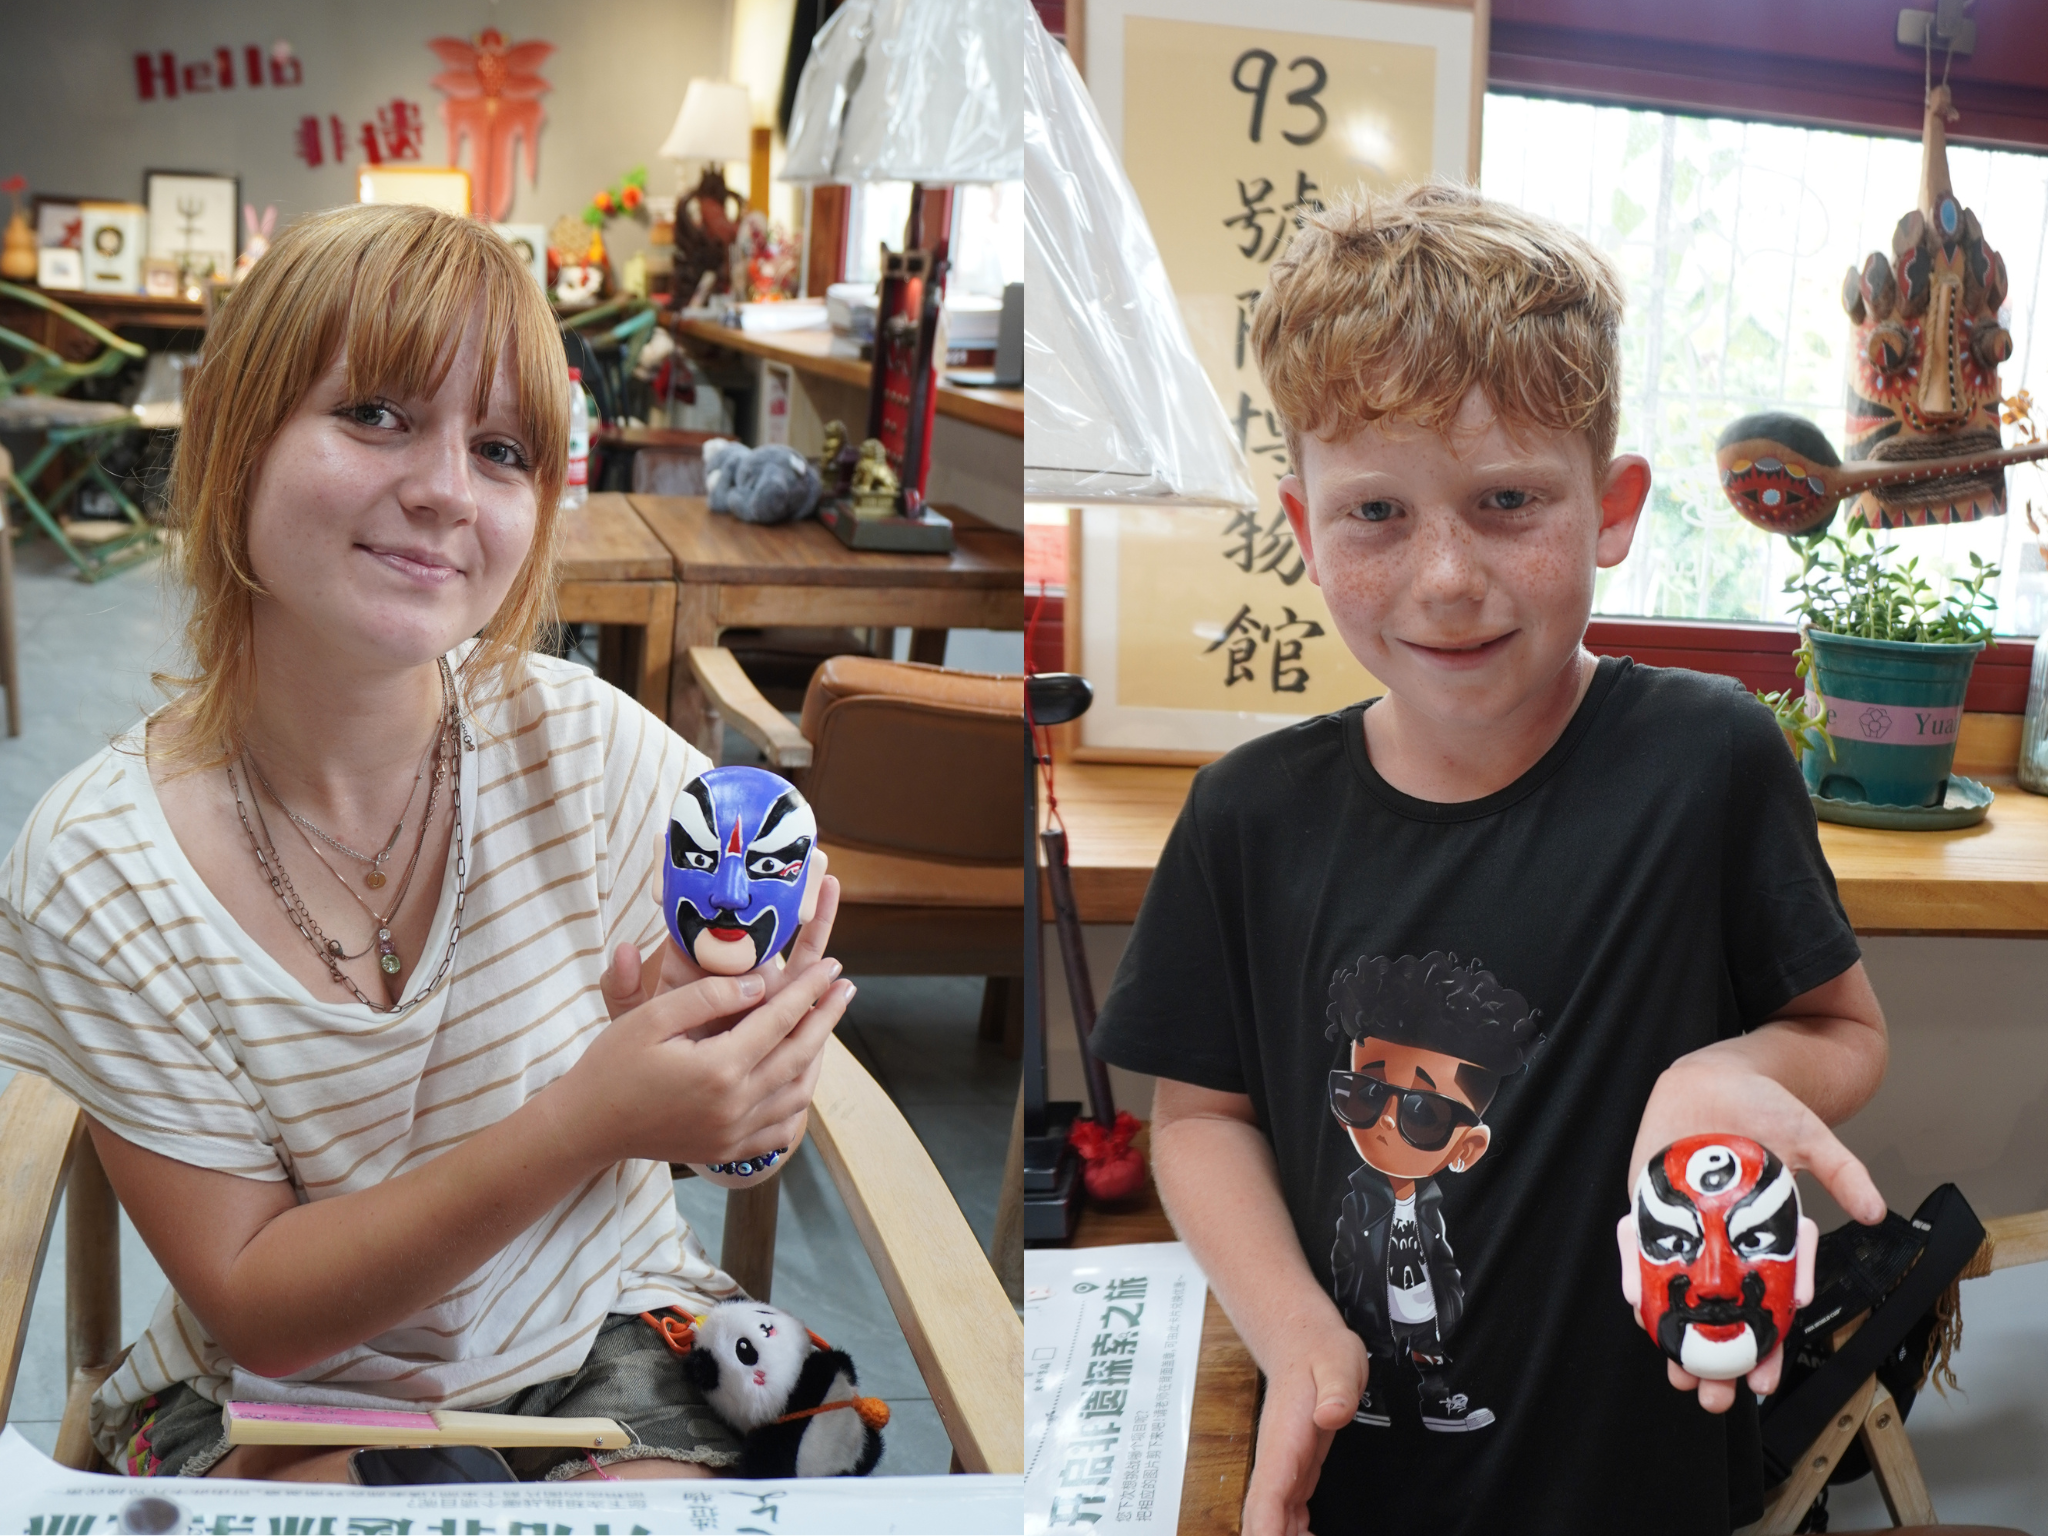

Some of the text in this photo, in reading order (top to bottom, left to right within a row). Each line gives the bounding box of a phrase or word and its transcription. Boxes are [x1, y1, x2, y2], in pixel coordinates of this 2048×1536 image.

[135, 45, 303, 100] Hello
[1915, 712, 1957, 736] Yua
[1048, 1276, 1149, 1527] 开启非遗探索之旅
